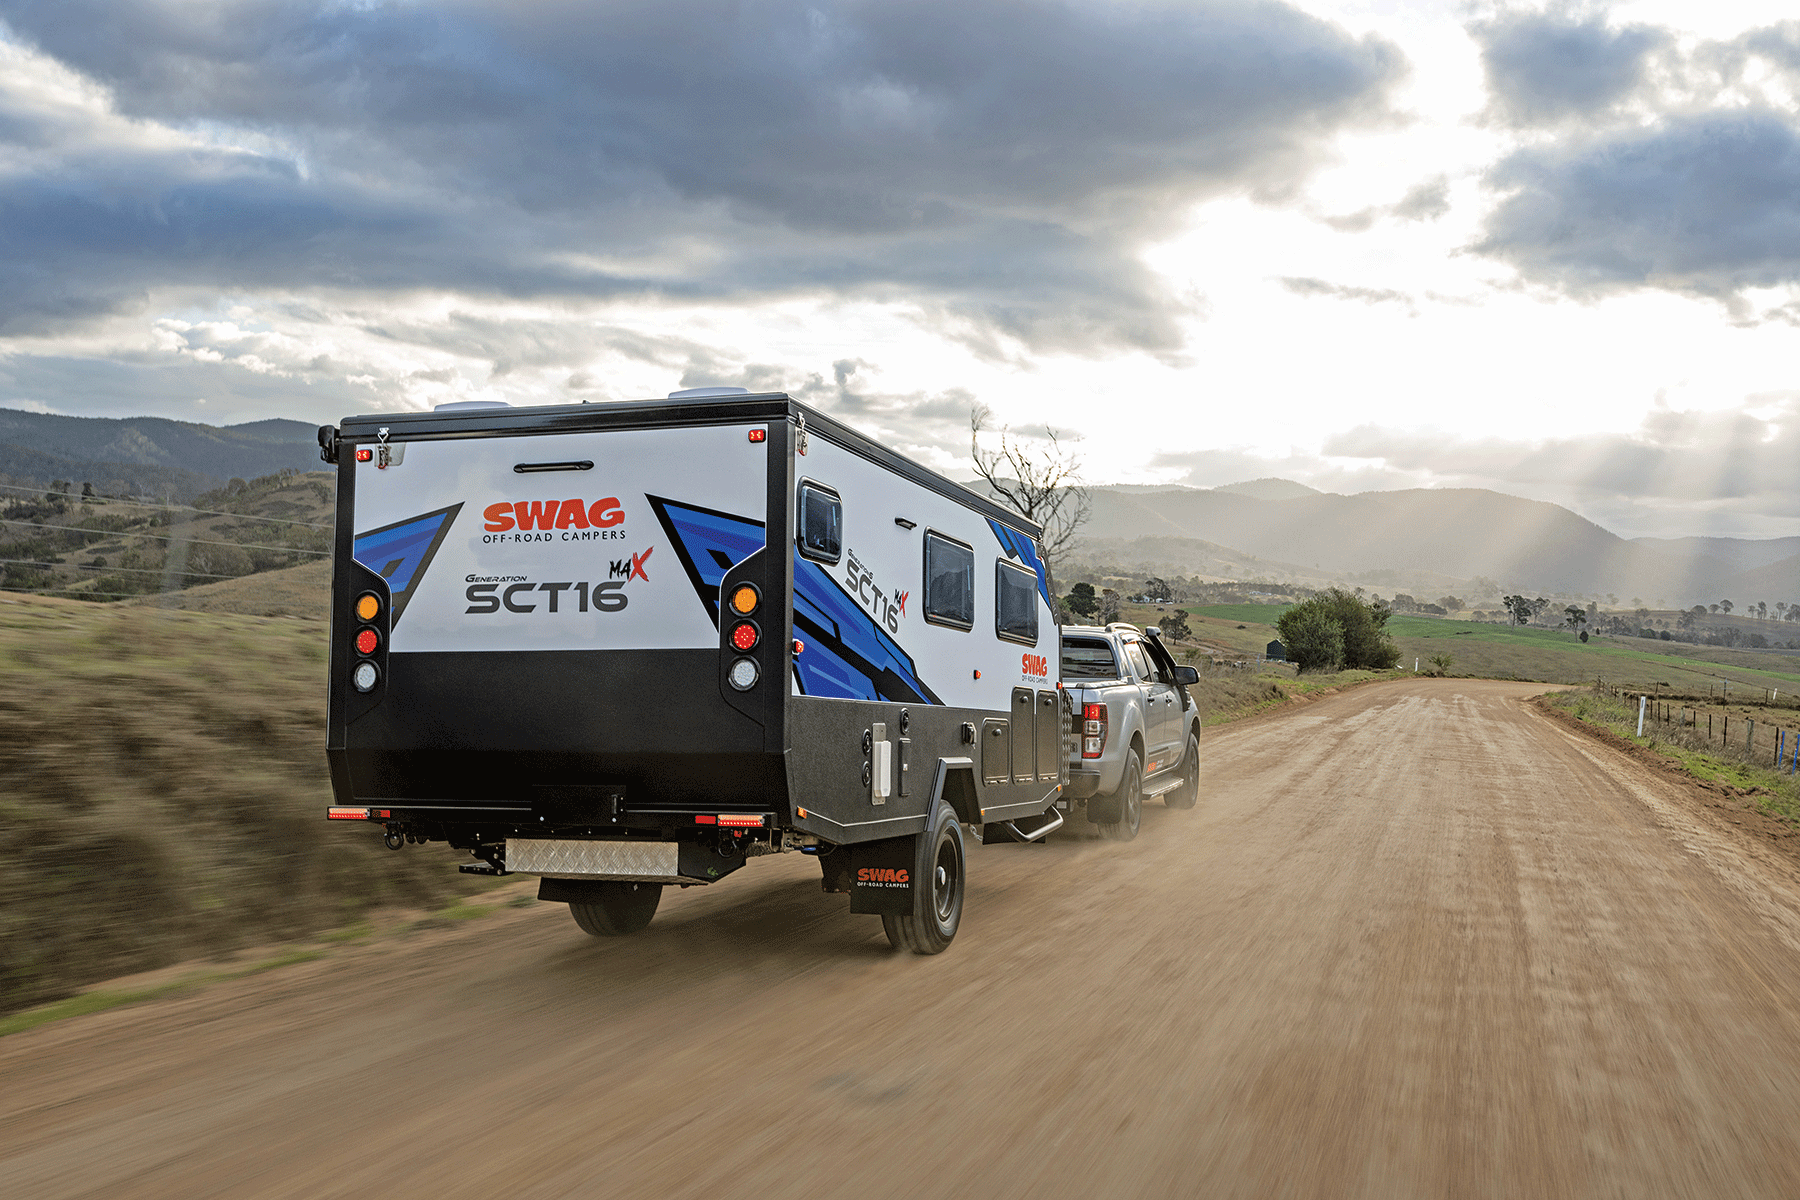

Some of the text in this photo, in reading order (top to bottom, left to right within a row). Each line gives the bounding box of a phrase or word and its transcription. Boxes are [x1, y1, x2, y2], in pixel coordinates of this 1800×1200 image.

[483, 496, 626, 532] SWAG
[482, 530, 626, 544] OFF-ROAD CAMPERS
[609, 545, 655, 583] MAX
[465, 581, 629, 614] SCT16
[845, 558, 899, 634] SCT16
[1021, 653, 1048, 678] SWAG
[857, 868, 909, 882] SWAG
